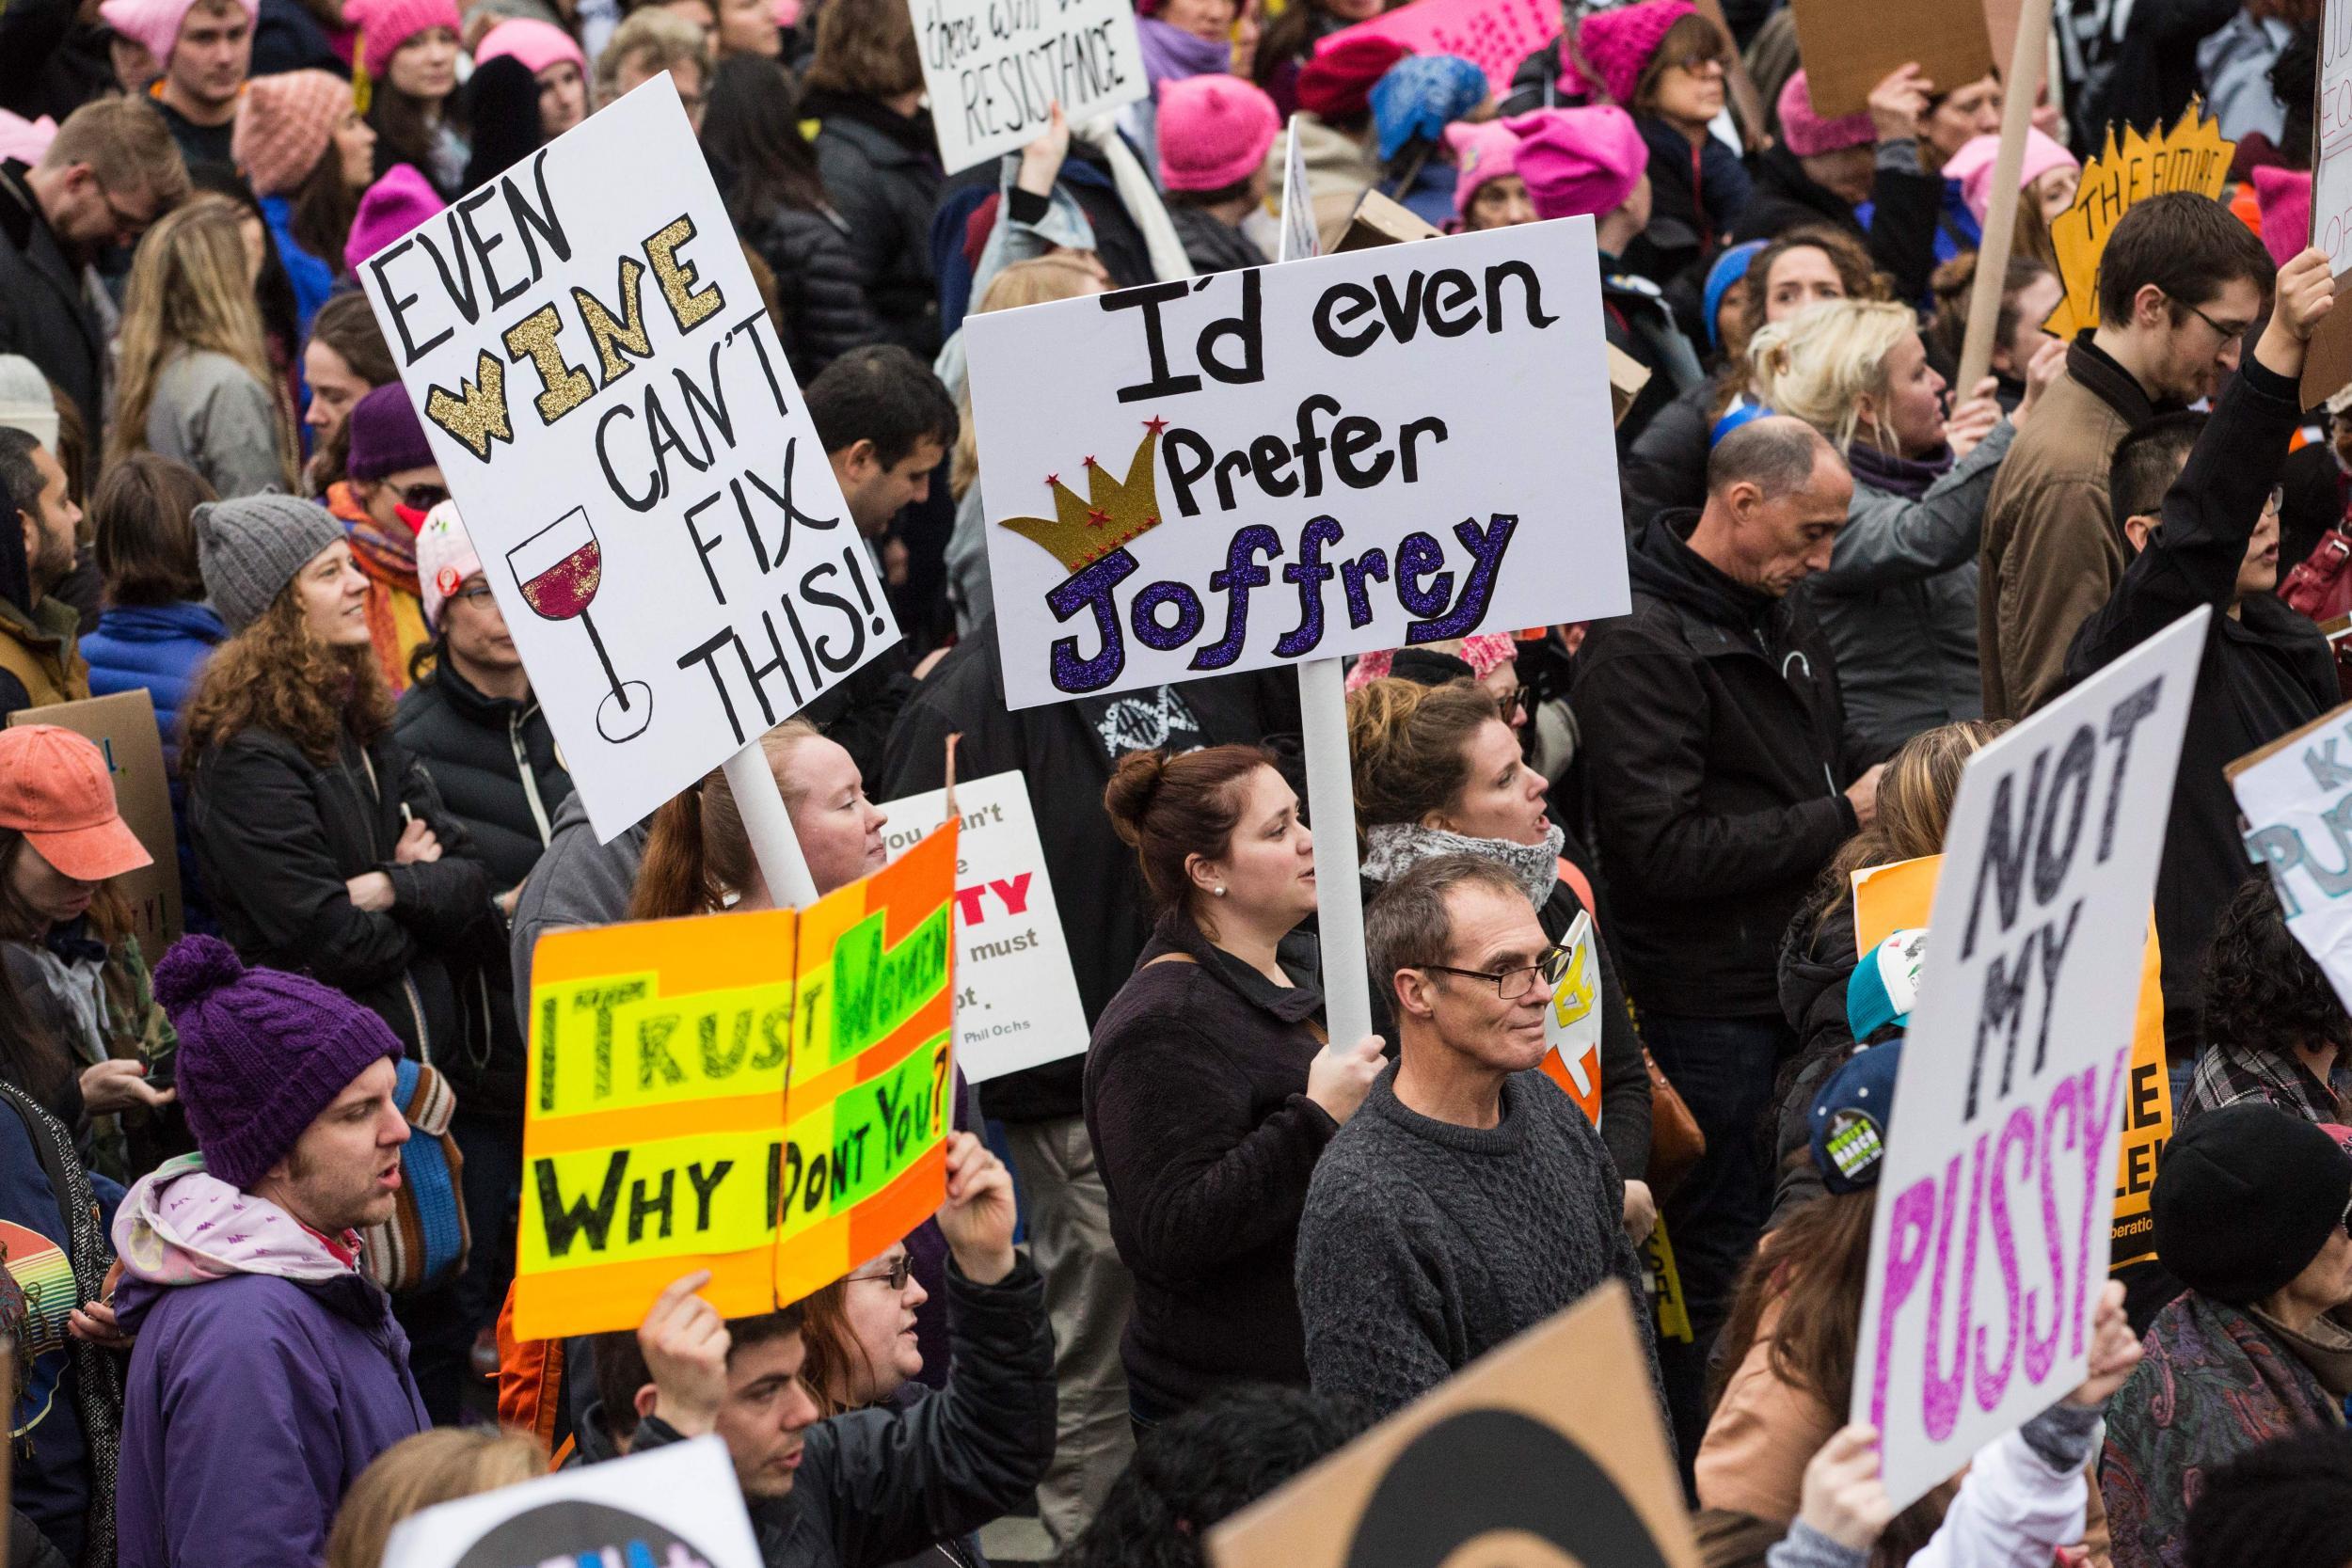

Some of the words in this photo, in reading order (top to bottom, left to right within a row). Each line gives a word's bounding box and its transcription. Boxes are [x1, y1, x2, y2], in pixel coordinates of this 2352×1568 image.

[961, 18, 1125, 146] RESISTANCE
[370, 148, 572, 367] EVEN
[2077, 157, 2142, 241] THE
[424, 213, 726, 464] WINE
[596, 308, 788, 514] CAN'T
[1099, 268, 1264, 404] I'd
[1311, 260, 1560, 357] even
[684, 436, 840, 605] FIX
[1161, 393, 1448, 517] Prefer
[676, 546, 885, 747] THIS!
[1045, 514, 1518, 694] Joffrey
[1960, 673, 2163, 960] NOT
[970, 927, 1039, 962] must
[1964, 897, 2083, 1123] MY
[539, 995, 558, 1113] I
[963, 1025, 990, 1045] Phil
[993, 1019, 1031, 1036] Ochs
[533, 1149, 735, 1259] WHY
[1867, 1044, 2132, 1479] PUSSY
